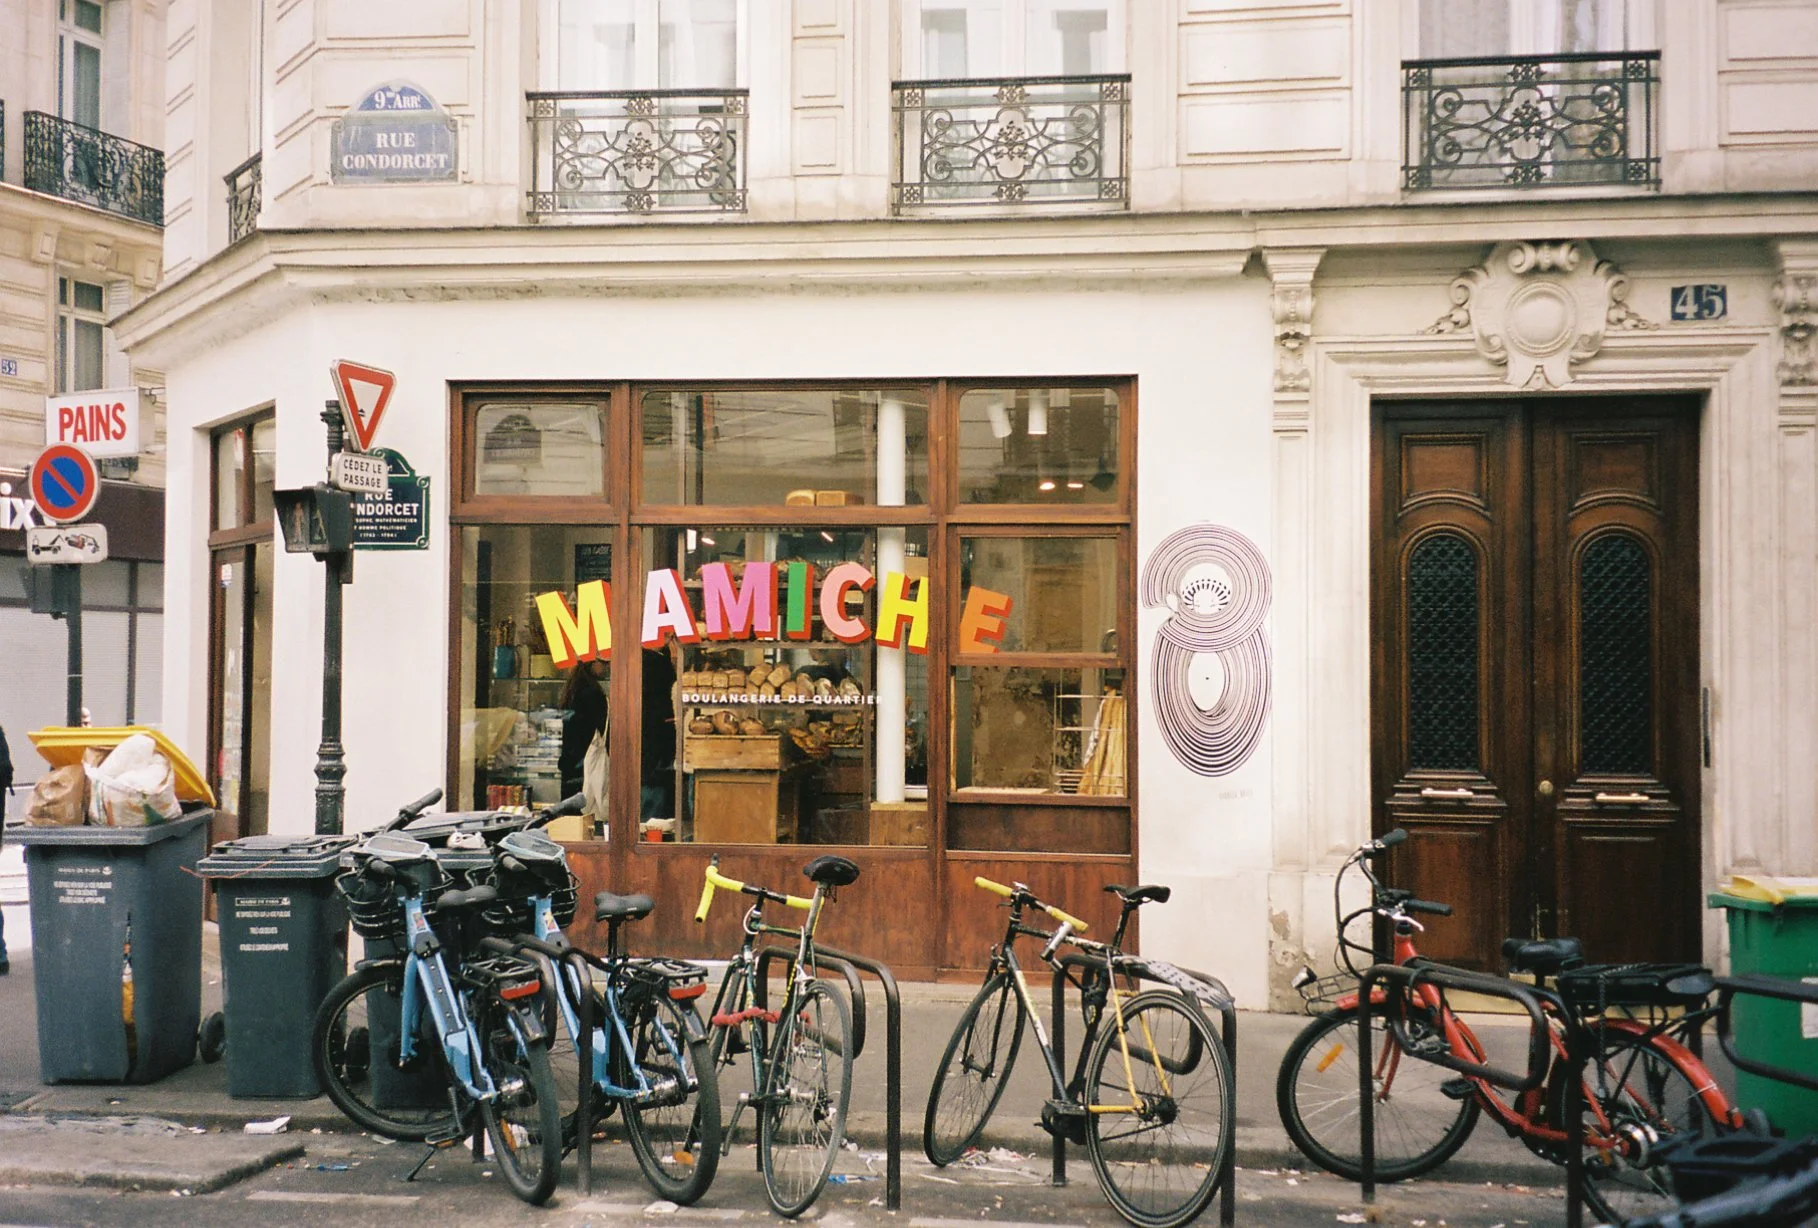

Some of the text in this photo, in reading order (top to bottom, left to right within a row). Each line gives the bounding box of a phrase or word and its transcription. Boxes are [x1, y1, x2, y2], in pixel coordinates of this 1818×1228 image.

[376, 132, 416, 149] RUE
[342, 154, 448, 170] CONDORCET
[1674, 285, 1724, 319] 45
[58, 402, 127, 443] PAINS
[343, 457, 370, 472] CÉDEZ
[372, 463, 382, 474] LE
[343, 473, 381, 488] PASSAGE
[356, 502, 419, 516] NDORCET
[535, 561, 1014, 670] MAMICHE
[682, 693, 782, 704] BOULANGERIE
[788, 694, 806, 704] DE
